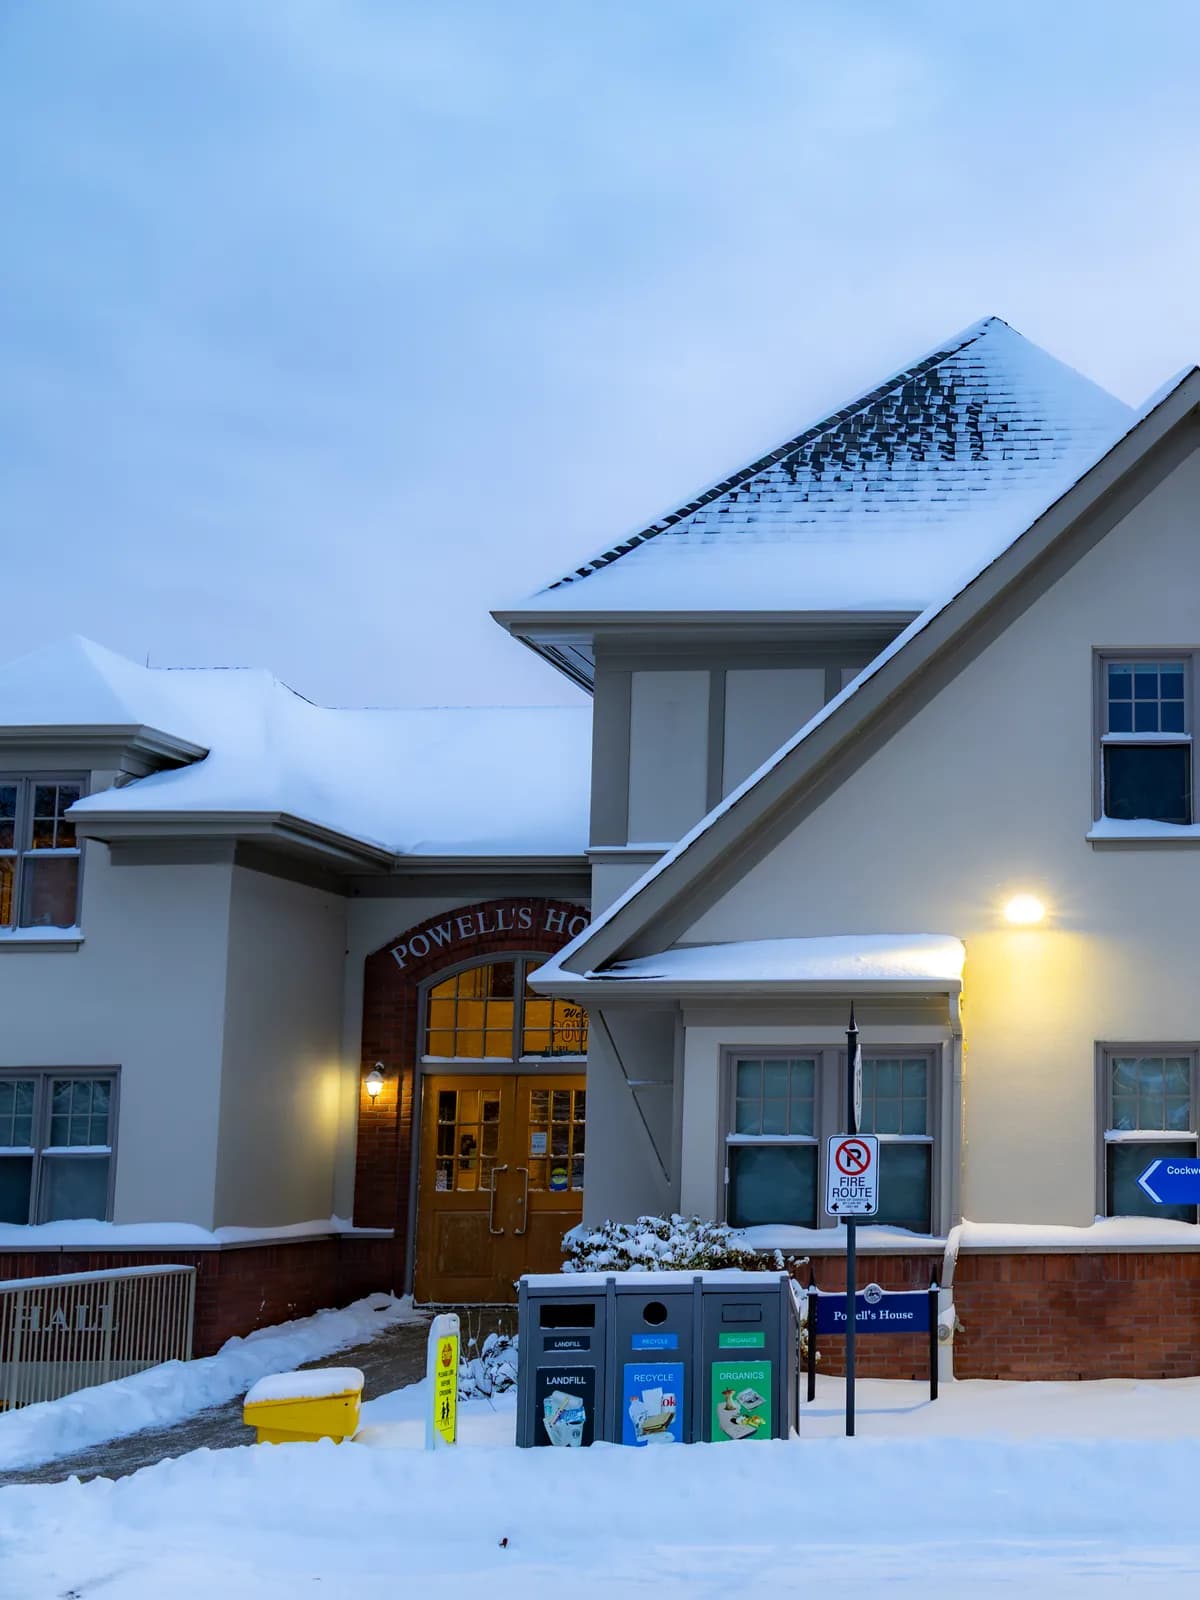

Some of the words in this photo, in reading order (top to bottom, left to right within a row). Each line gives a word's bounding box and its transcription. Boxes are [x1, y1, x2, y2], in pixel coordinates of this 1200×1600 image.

[390, 907, 533, 970] POWELL'S
[839, 1176, 865, 1187] FIRE
[832, 1187, 873, 1198] ROUTE
[833, 1310, 876, 1321] Poell's
[879, 1310, 914, 1320] House
[554, 1340, 581, 1348] LANDFILL
[546, 1376, 587, 1385] LANDFILL
[633, 1373, 674, 1382] RECYCLE
[719, 1371, 765, 1381] ORGANICS
